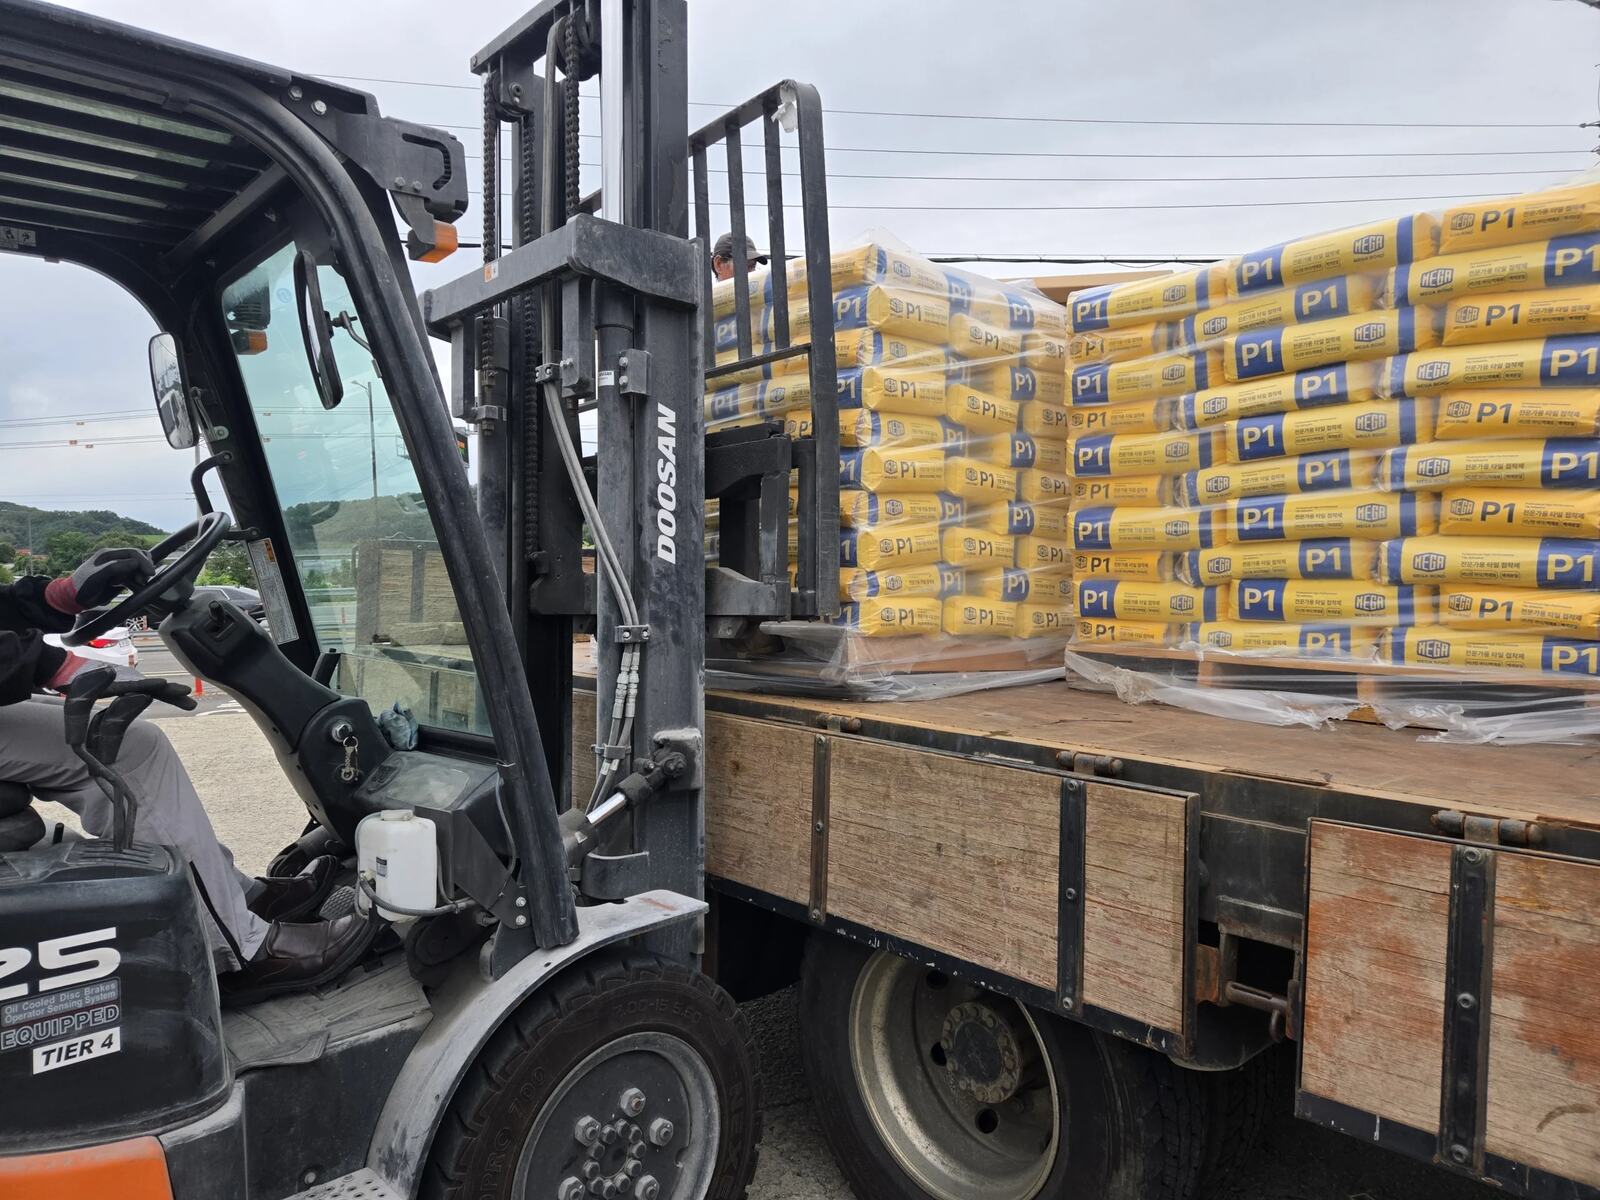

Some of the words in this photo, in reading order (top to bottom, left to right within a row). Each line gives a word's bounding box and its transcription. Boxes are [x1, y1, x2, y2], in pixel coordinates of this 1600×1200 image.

[1480, 207, 1516, 231] P1
[1354, 235, 1384, 254] MEGA
[1555, 244, 1600, 276] P1
[1242, 257, 1273, 285] P1
[1421, 268, 1453, 288] MEGA
[837, 297, 861, 320] P1
[1302, 285, 1338, 315] P1
[906, 302, 921, 321] P1
[1014, 304, 1031, 322] P1
[1077, 302, 1101, 323] P1
[1486, 303, 1521, 326] P1
[1204, 317, 1227, 335] MEGA
[1355, 323, 1385, 342] MEGA
[985, 332, 999, 350] P1
[1242, 340, 1273, 367] P1
[1550, 347, 1599, 377] P1
[1015, 372, 1032, 391] P1
[1417, 362, 1450, 381] MEGA
[901, 380, 916, 398] P1
[1077, 374, 1102, 395] P1
[1301, 371, 1337, 400] P1
[982, 401, 996, 419] P1
[1204, 397, 1227, 414] MEGA
[1477, 403, 1513, 424] P1
[1056, 411, 1068, 428] P1
[1087, 411, 1106, 428] P1
[1356, 413, 1386, 431] MEGA
[1243, 424, 1275, 450] P1
[1015, 440, 1032, 459] P1
[1078, 447, 1103, 467] P1
[900, 461, 916, 478] P1
[1305, 458, 1341, 485] P1
[1417, 458, 1450, 477] MEGA
[1551, 451, 1599, 480] P1
[657, 402, 677, 565] DOOSAN
[980, 471, 994, 488] P1
[1054, 479, 1066, 495] P1
[1206, 476, 1230, 492] MEGA
[1090, 483, 1110, 499] P1
[945, 502, 961, 522] P1
[1013, 508, 1030, 526] P1
[1243, 507, 1275, 530] P1
[1356, 504, 1387, 522] MEGA
[1480, 501, 1516, 523] P1
[1078, 521, 1103, 541] P1
[896, 537, 912, 556] P1
[979, 540, 993, 556] P1
[1051, 547, 1064, 563] P1
[1090, 557, 1110, 573] P1
[1207, 557, 1231, 574] MEGA
[1306, 547, 1342, 572] P1
[1413, 552, 1445, 572] MEGA
[1547, 554, 1593, 582] P1
[944, 566, 962, 587] P1
[1008, 575, 1026, 594] P1
[1083, 590, 1109, 610] P1
[1170, 595, 1193, 611] MEGA
[1244, 588, 1276, 611] P1
[1355, 594, 1385, 611] MEGA
[1478, 598, 1514, 621] P1
[899, 608, 914, 625] P1
[980, 609, 993, 625] P1
[1046, 612, 1059, 627] P1
[1096, 624, 1115, 640] P1
[1306, 632, 1342, 656] P1
[1417, 639, 1450, 659] MEGA
[1552, 646, 1598, 673] P1
[4, 1005, 18, 1015] Oil
[22, 996, 55, 1011] Cooled
[60, 990, 80, 1002] Disc
[84, 982, 116, 996] Brakes
[4, 1007, 46, 1025] Operator
[47, 999, 83, 1013] Sensing
[85, 990, 116, 1004] System
[1, 1004, 120, 1050] EQUIPPED
[42, 1039, 94, 1067] TIER
[101, 1033, 114, 1049] 4
